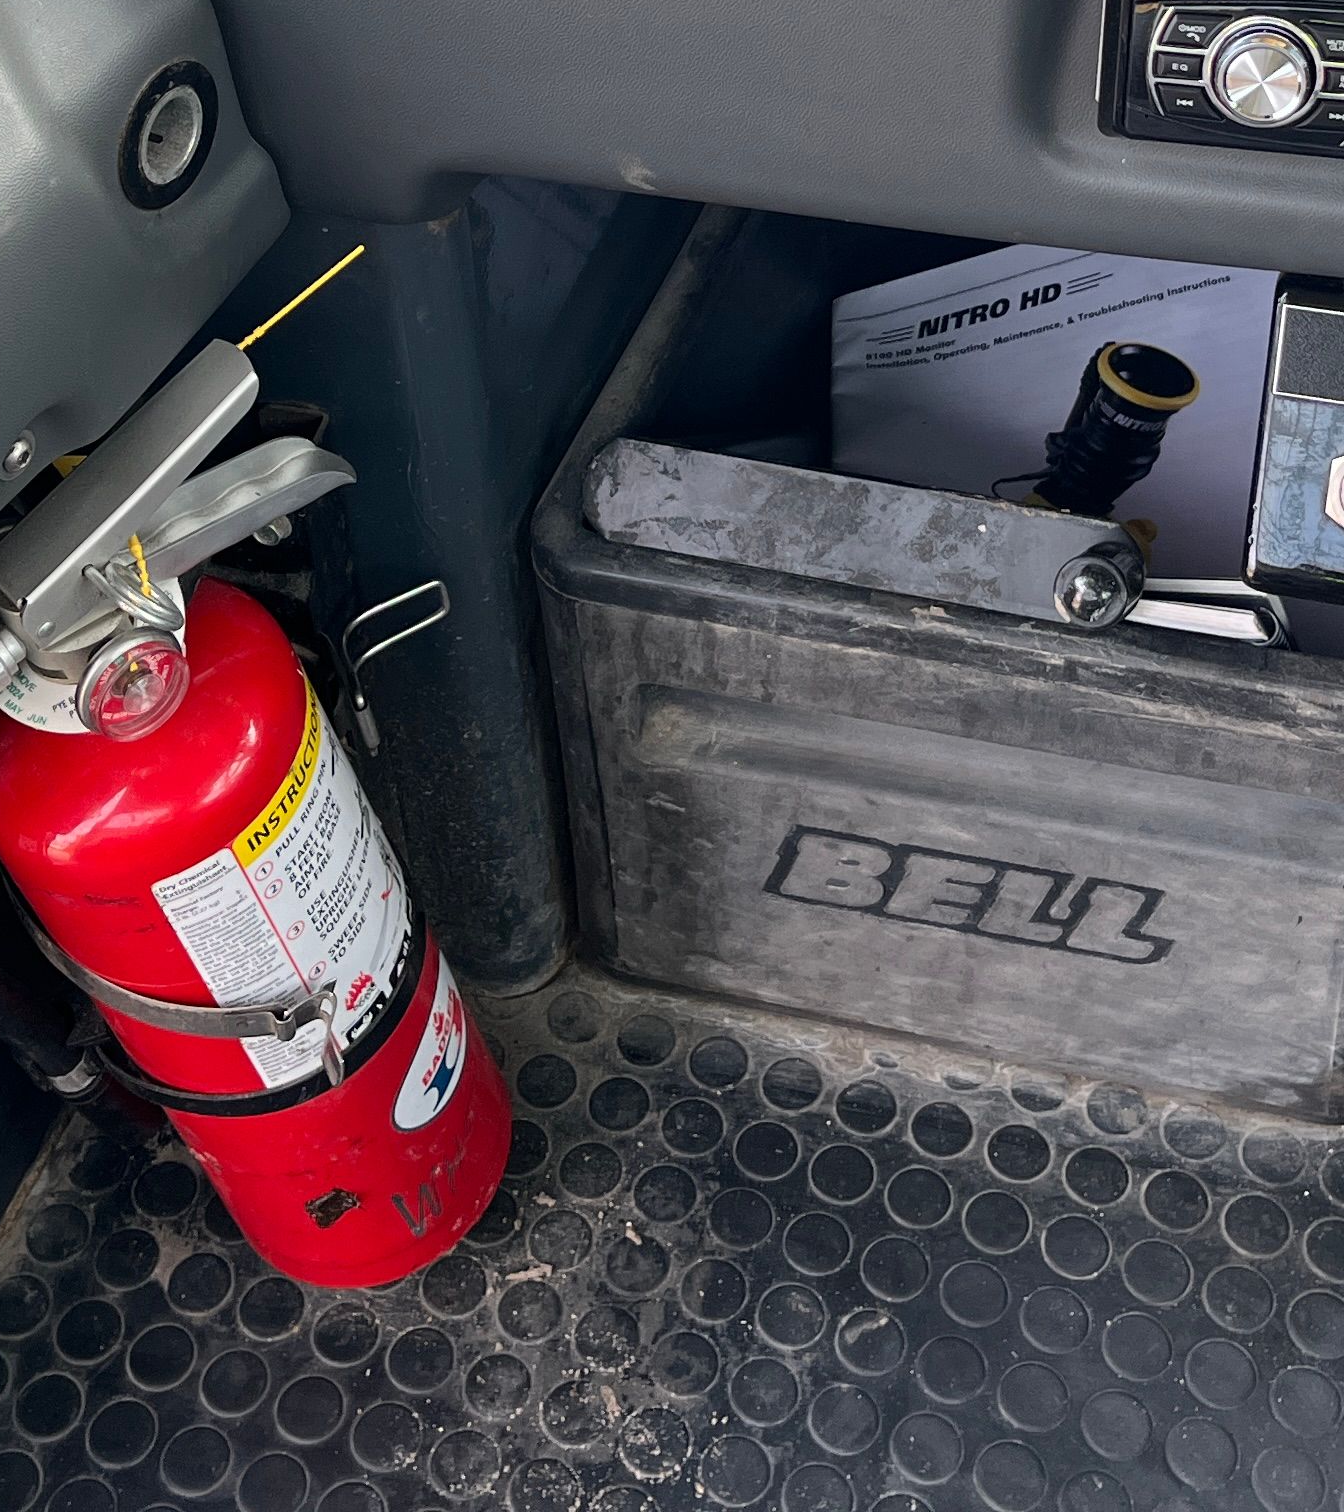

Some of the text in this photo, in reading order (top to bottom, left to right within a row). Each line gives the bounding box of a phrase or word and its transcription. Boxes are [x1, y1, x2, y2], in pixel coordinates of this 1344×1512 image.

[1171, 62, 1189, 72] EQ
[865, 274, 1231, 370] Installation, Operating, Maintenance, & Troubleshooting Instructions
[917, 282, 1063, 340] NITRO HD
[914, 339, 957, 354] Monitor
[4, 699, 47, 725] MAY JUN
[6, 682, 24, 700] 2024
[275, 826, 300, 858] PULL
[300, 787, 319, 824] RING
[284, 832, 315, 876] START
[315, 788, 332, 832] FROM
[290, 799, 336, 883] 8 FEET BACK
[295, 805, 342, 892] AIM AT BASE
[159, 860, 220, 893] Dry Chemical
[298, 881, 312, 899] OF
[307, 889, 328, 916] USE
[311, 827, 360, 925] EXTINGUISHER
[762, 822, 1177, 965] BELL
[320, 882, 357, 941] SQUEEZE
[328, 911, 358, 957] SWEEP
[359, 878, 373, 911] SIDE
[332, 915, 367, 965] TO SIDE
